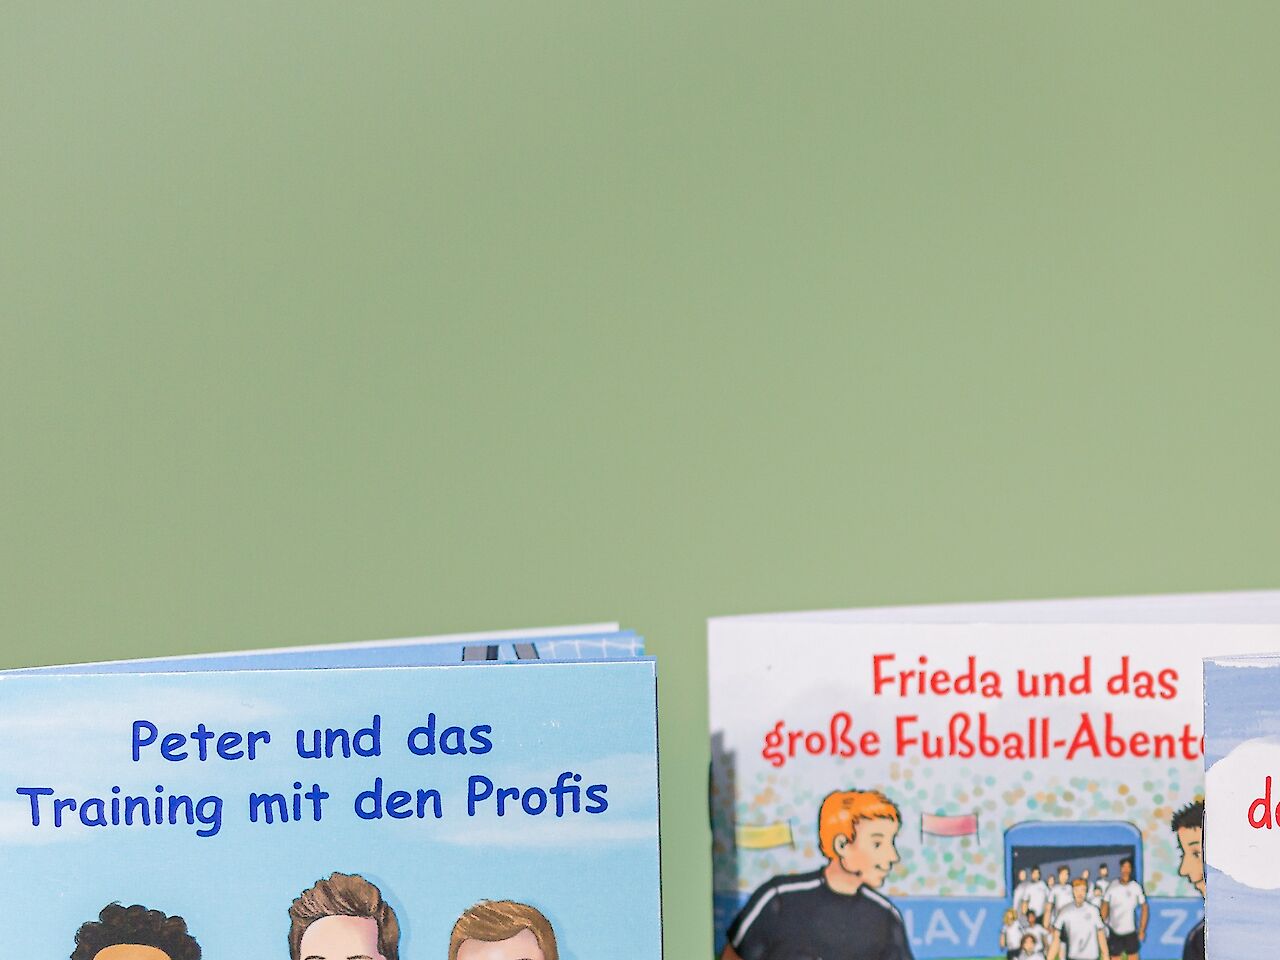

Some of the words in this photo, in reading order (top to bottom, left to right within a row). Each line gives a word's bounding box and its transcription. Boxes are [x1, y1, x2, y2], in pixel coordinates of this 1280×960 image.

[871, 653, 1004, 699] Frieda
[1016, 655, 1093, 700] und
[1105, 655, 1180, 701] das
[131, 719, 271, 763] Peter
[295, 713, 382, 760] und
[406, 712, 494, 756] das
[760, 711, 881, 768] große
[895, 711, 1204, 761] Fußball-Abent
[15, 784, 225, 838] Training
[248, 780, 330, 825] mit
[353, 776, 444, 820] den
[466, 770, 610, 818] Profis
